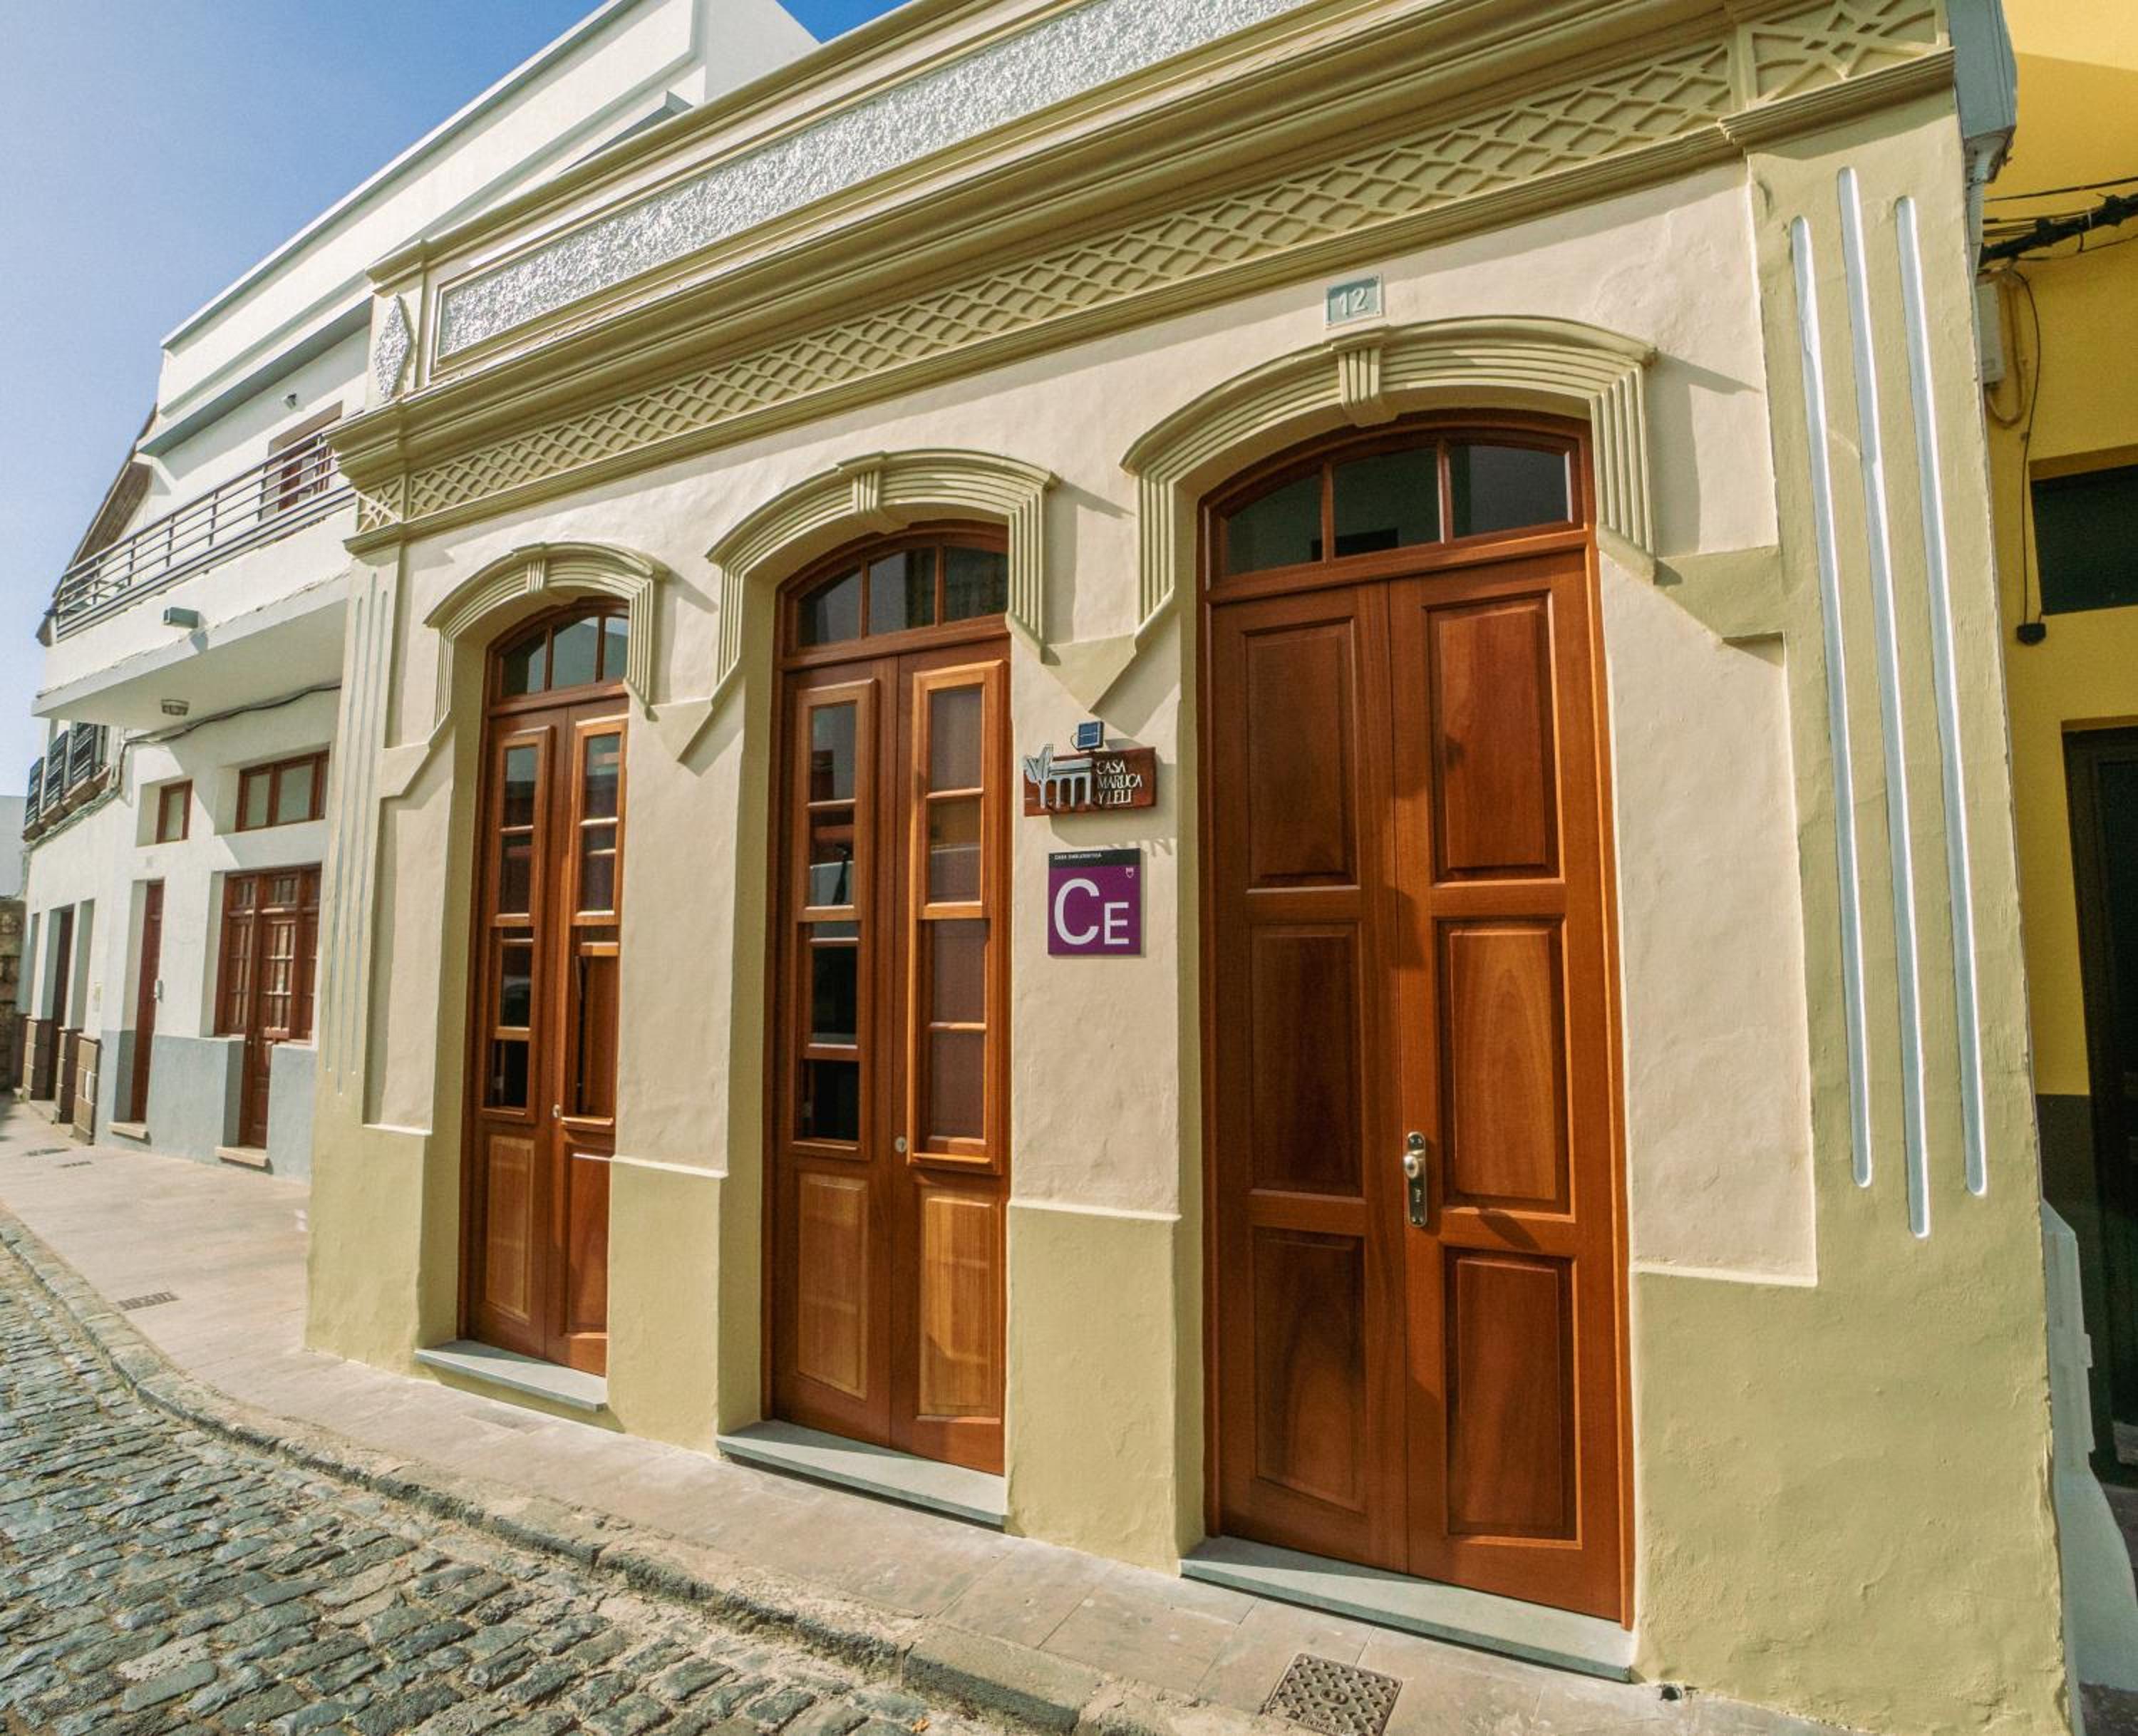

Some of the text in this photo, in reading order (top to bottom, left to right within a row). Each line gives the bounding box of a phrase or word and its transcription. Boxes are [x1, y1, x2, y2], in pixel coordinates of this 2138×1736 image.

[1339, 287, 1366, 315] 12
[1097, 759, 1126, 775] CASA
[1098, 773, 1142, 789] MARUCA
[1098, 790, 1131, 805] Y LELI
[1054, 877, 1129, 945] CE
